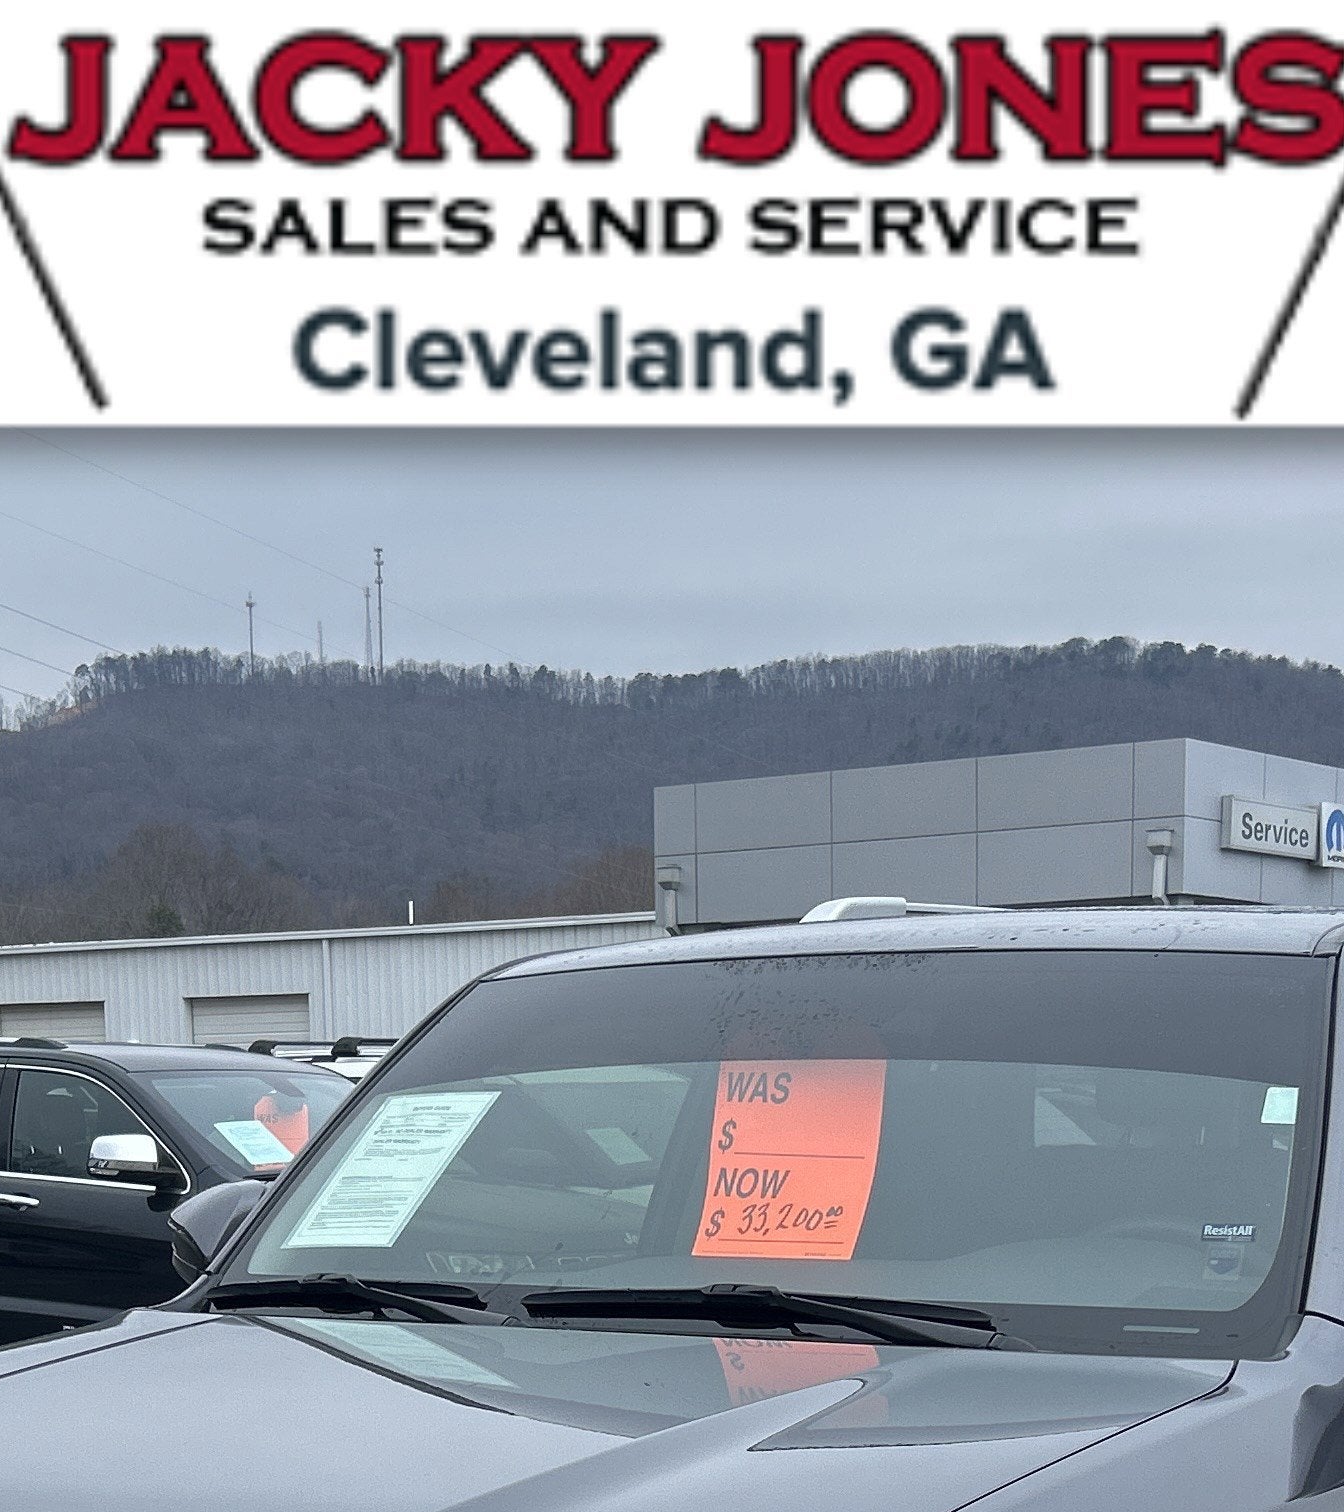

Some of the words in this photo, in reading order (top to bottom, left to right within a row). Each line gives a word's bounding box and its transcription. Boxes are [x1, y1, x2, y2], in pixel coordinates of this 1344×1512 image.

[1241, 812, 1310, 848] Service
[725, 1071, 793, 1105] WAS
[717, 1118, 738, 1155] $
[713, 1167, 791, 1199] NOW
[704, 1206, 726, 1242] $
[1203, 1225, 1254, 1236] ResistAll
